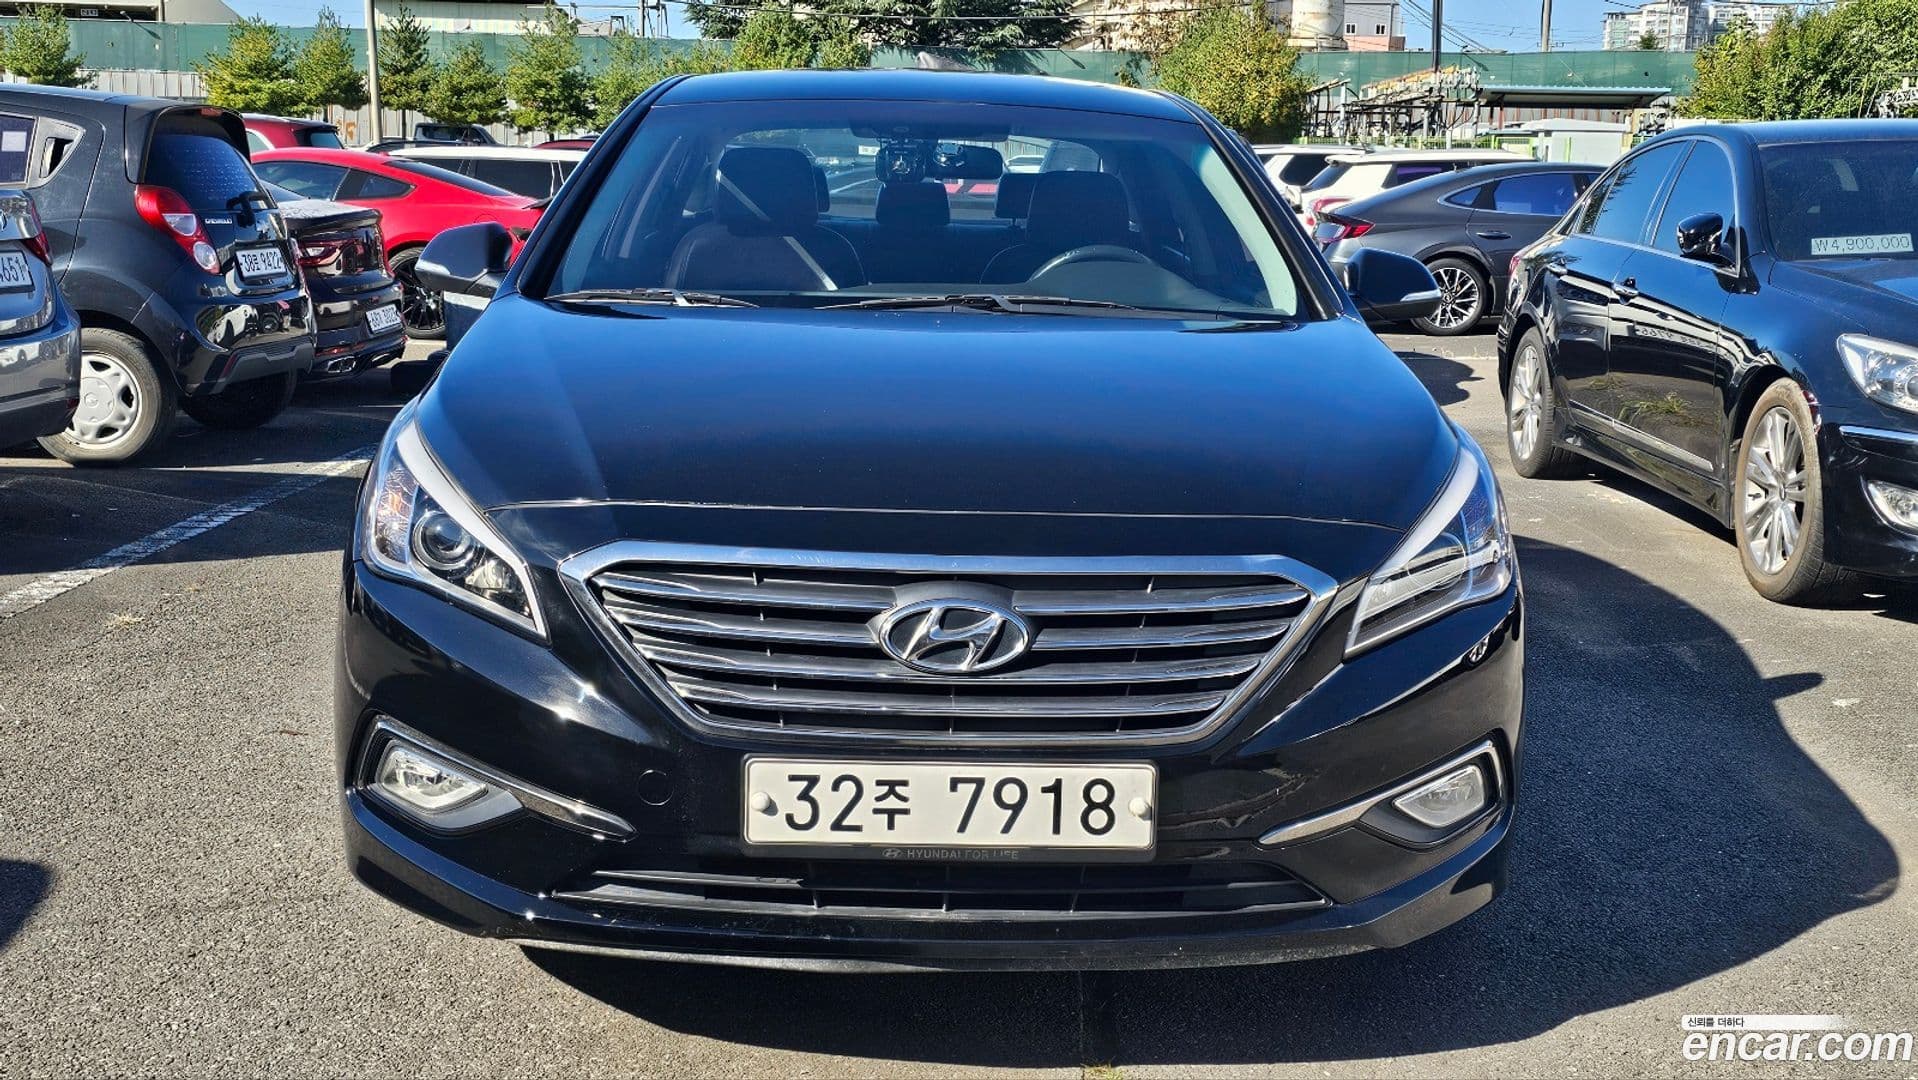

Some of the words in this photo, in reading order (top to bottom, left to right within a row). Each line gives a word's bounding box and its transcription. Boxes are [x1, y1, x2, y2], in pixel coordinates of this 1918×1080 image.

[784, 773, 911, 832] 32주
[948, 776, 1116, 835] 7918
[907, 849, 961, 860] HYUNDAI
[964, 849, 989, 861] FOR
